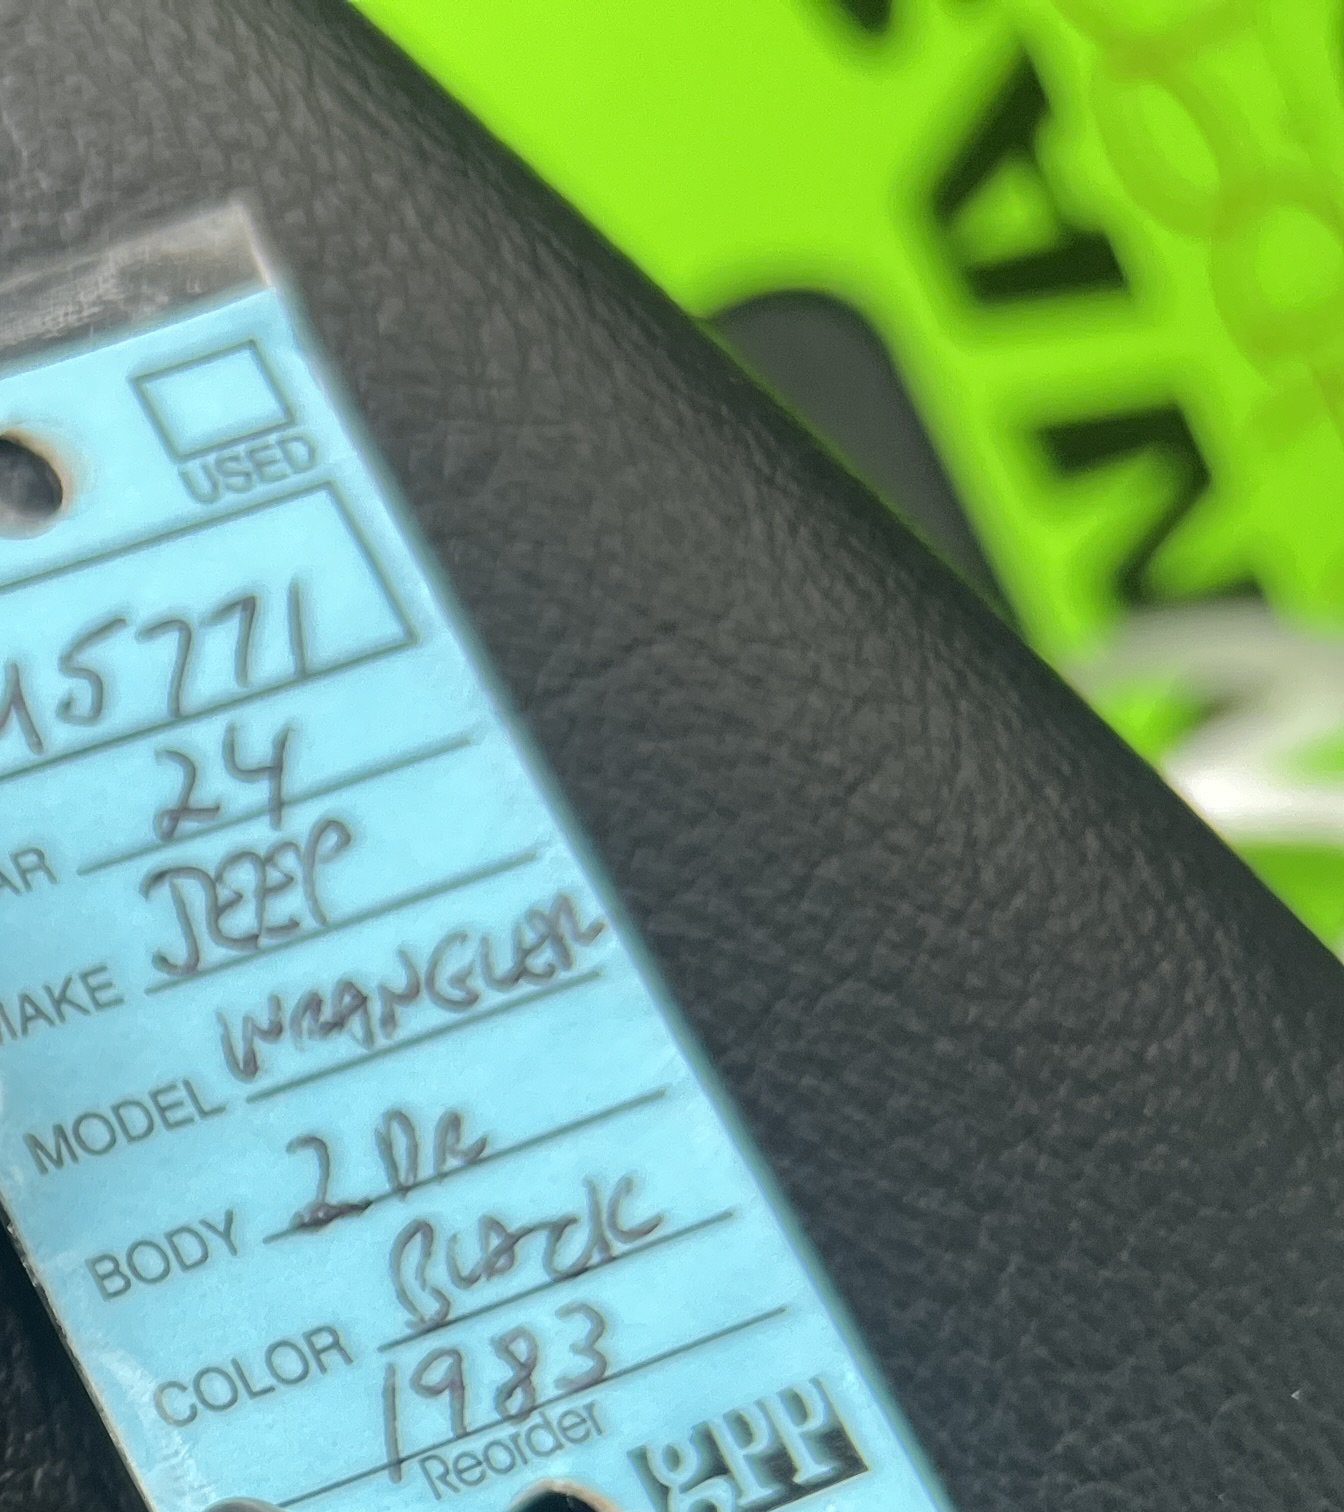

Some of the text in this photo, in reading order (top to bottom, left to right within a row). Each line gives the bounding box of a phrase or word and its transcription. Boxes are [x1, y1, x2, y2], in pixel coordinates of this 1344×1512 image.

[178, 434, 318, 504] USED
[152, 722, 294, 842] 24
[140, 818, 352, 976] JEEP
[216, 895, 606, 1082] WRANGLER
[23, 1079, 227, 1176] MODEL
[286, 1133, 374, 1232] 2
[85, 1209, 238, 1301] BODY
[153, 1326, 354, 1427] COLOR
[382, 1303, 608, 1484] 1983
[418, 1402, 604, 1500] Reorder
